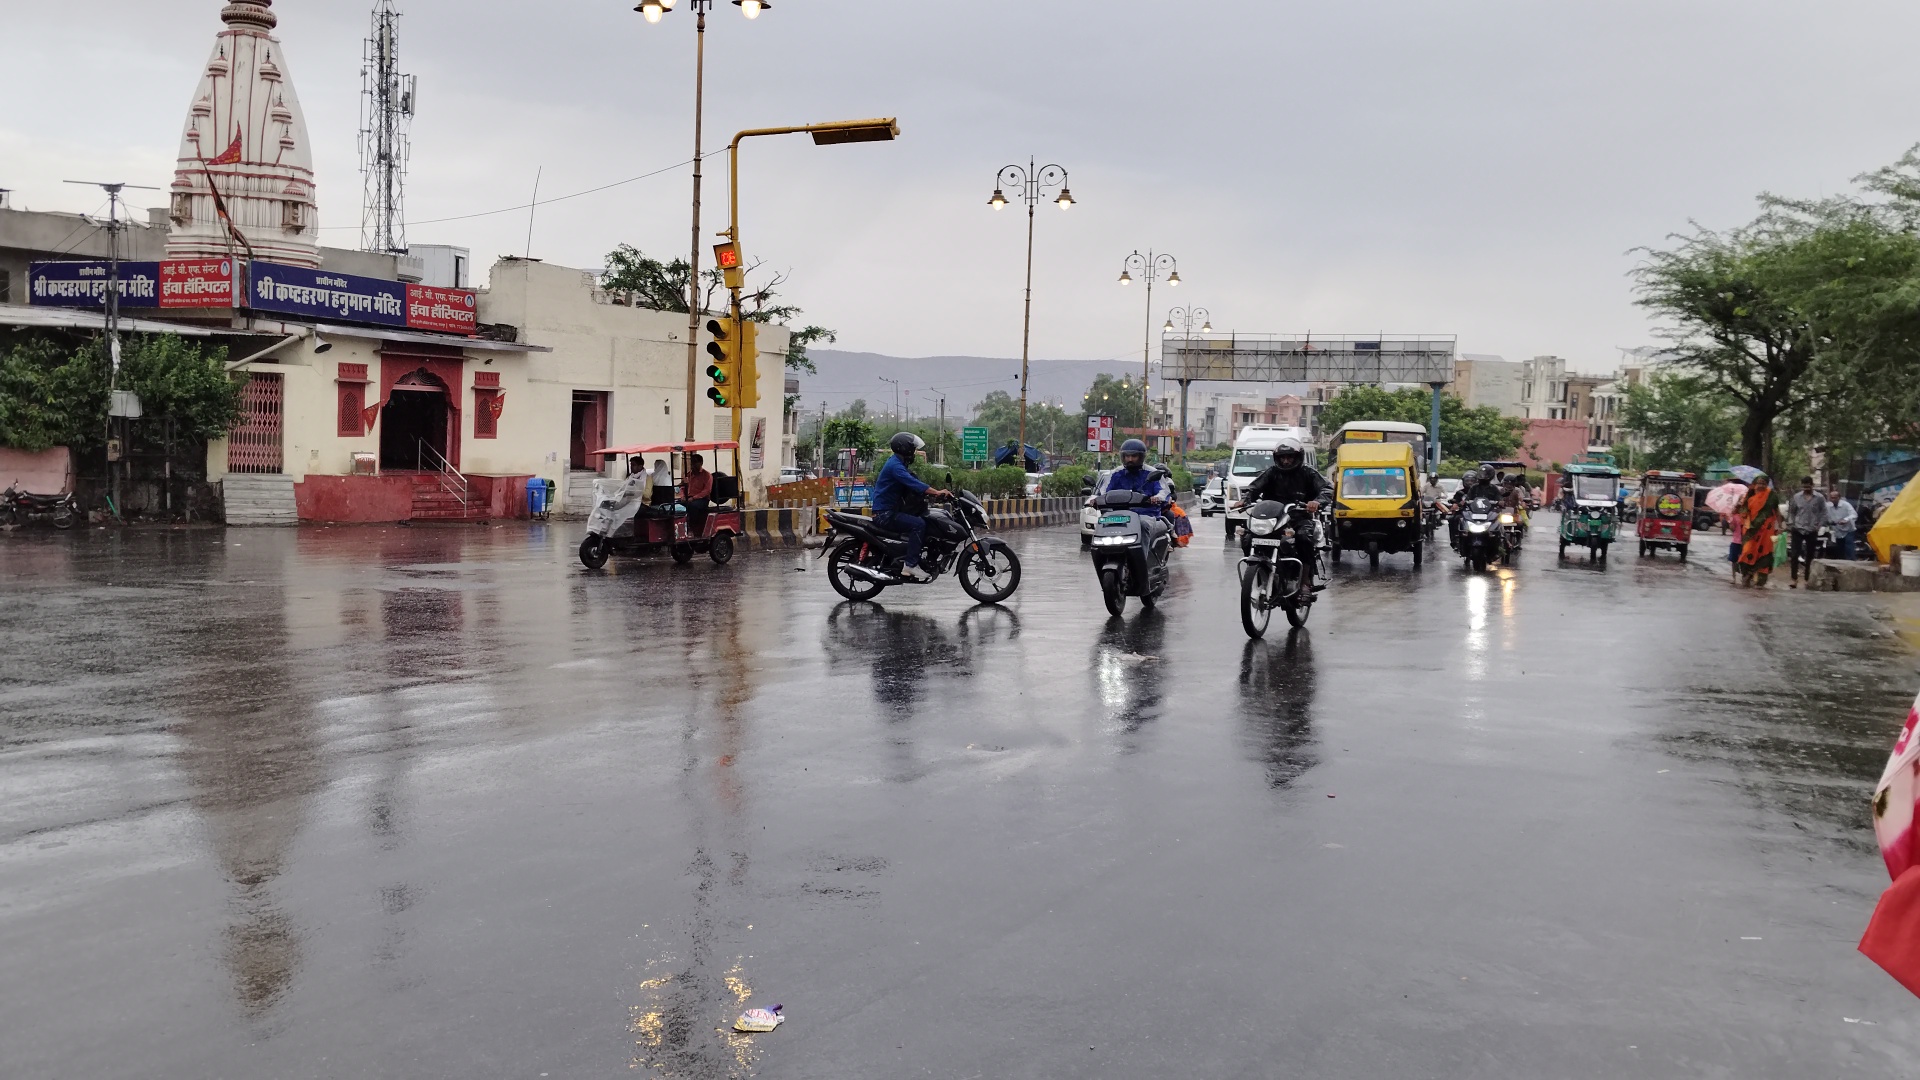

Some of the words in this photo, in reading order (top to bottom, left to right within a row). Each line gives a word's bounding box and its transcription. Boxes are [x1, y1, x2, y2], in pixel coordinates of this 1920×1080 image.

[34, 275, 46, 296] श्री
[47, 279, 91, 297] कष्टहरण
[128, 274, 155, 297] मंदिर
[163, 277, 183, 296] ईवा
[184, 277, 230, 294] हॉस्पिटल
[333, 277, 348, 288] मंदिर
[257, 276, 274, 300] श्री
[275, 282, 330, 307] कष्टहरण
[331, 290, 372, 316] हनुमान
[373, 291, 401, 316] मंदिर
[410, 301, 430, 317] ईवा
[431, 303, 474, 321] हॉस्पिटल
